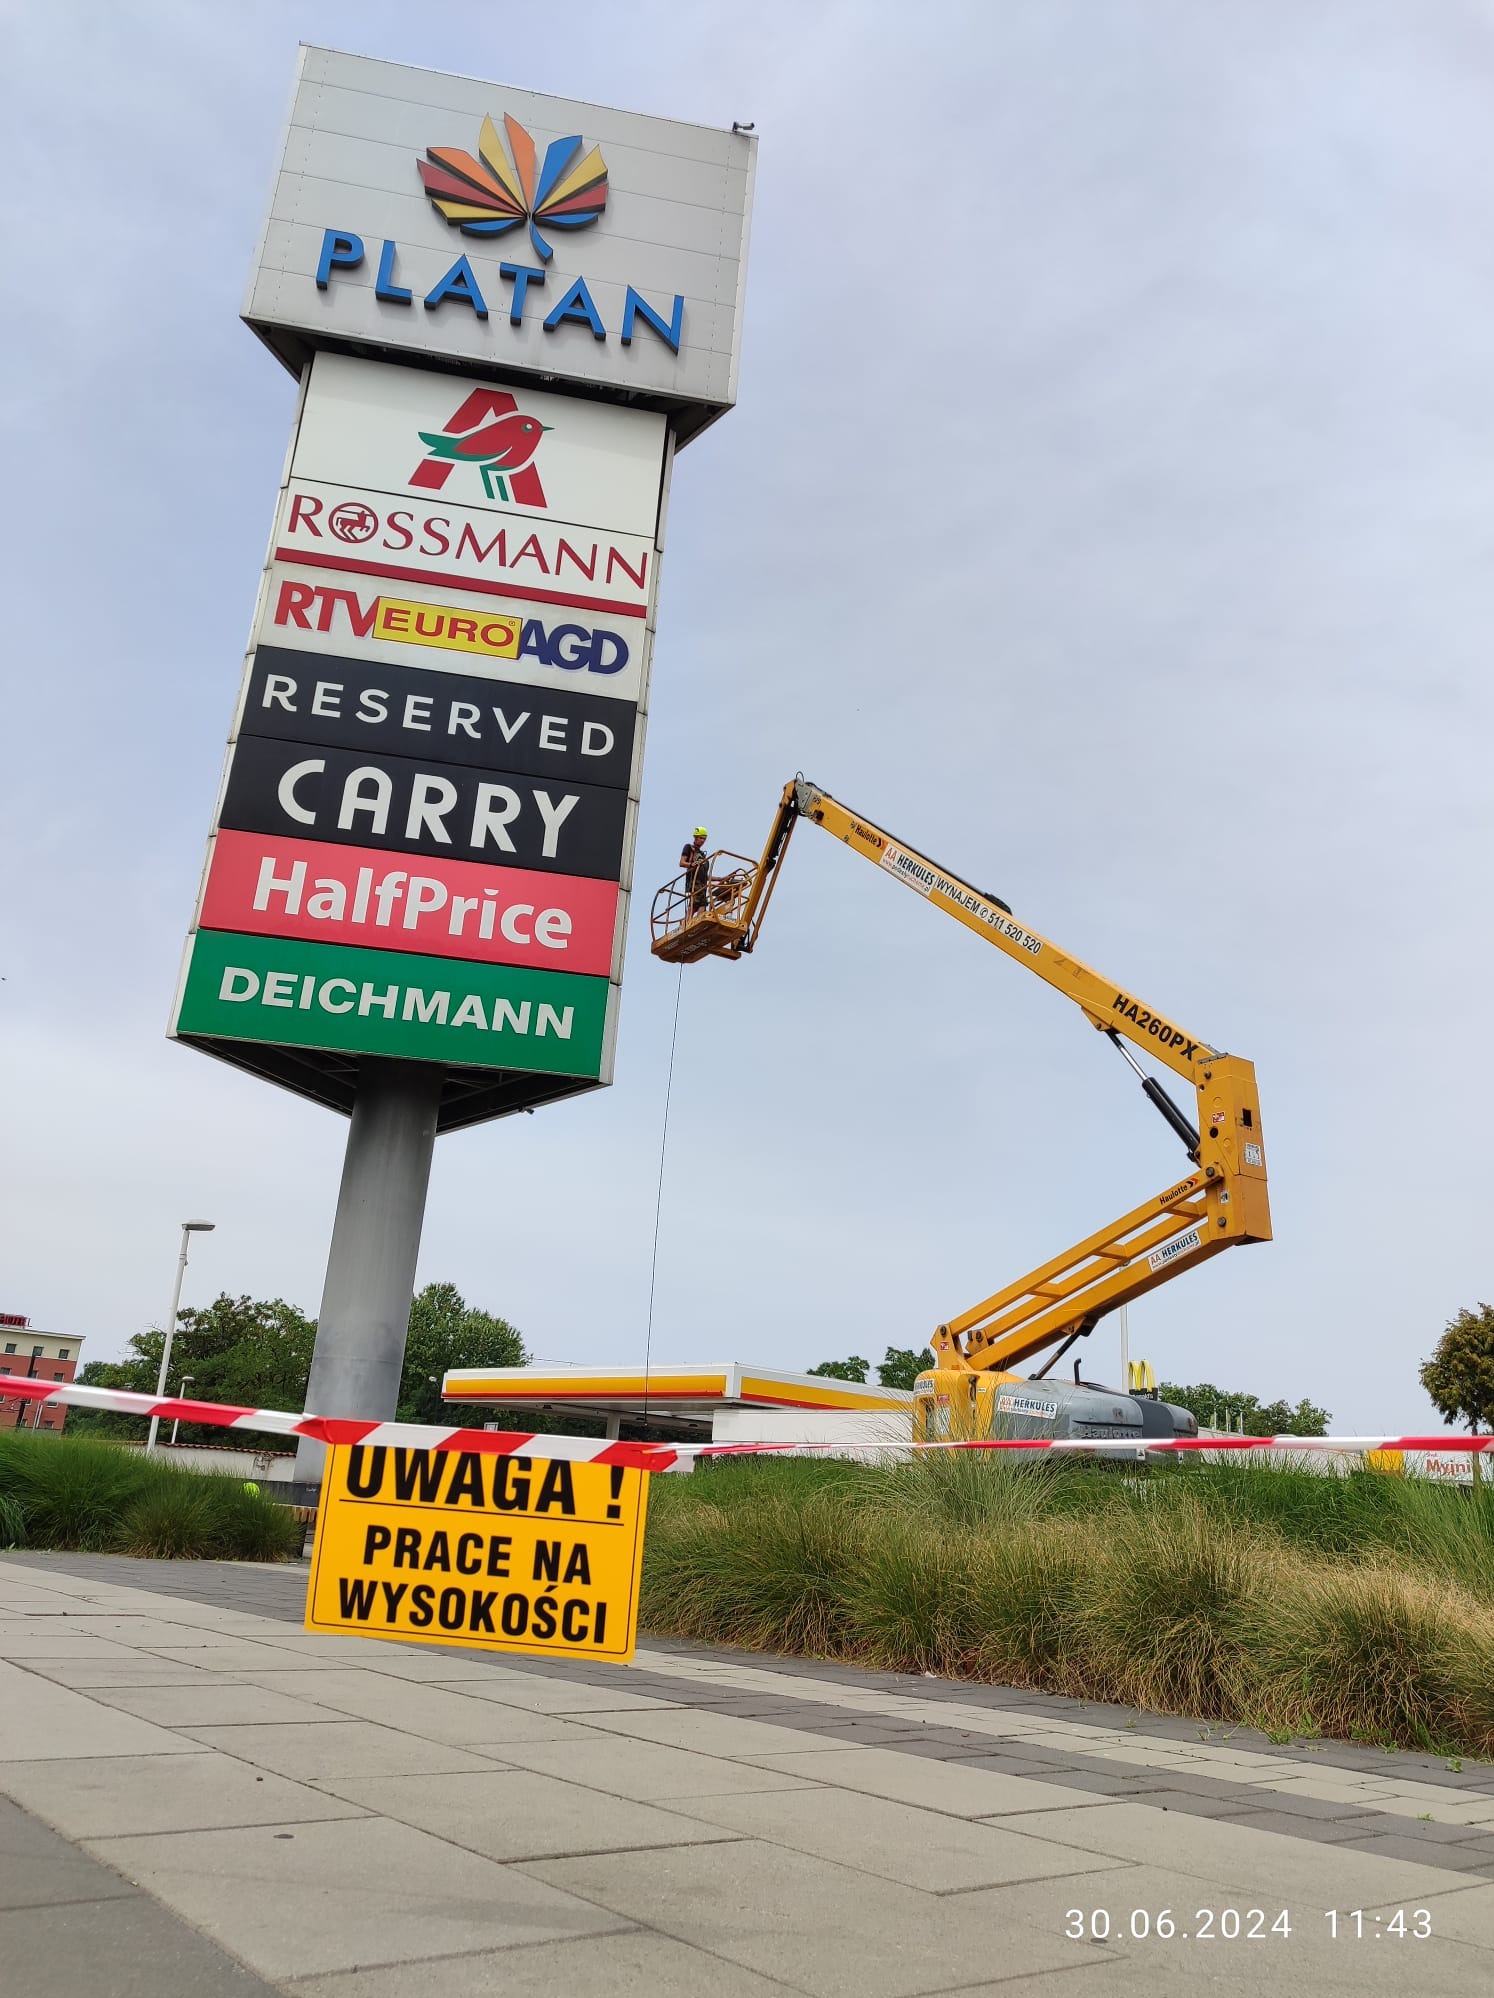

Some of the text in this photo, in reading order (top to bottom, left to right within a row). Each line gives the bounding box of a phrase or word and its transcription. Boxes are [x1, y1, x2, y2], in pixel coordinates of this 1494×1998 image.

[315, 228, 685, 355] PLATAN
[288, 494, 648, 590] ROSSMANN
[274, 580, 630, 675] RTV EURO AGD
[262, 674, 615, 756] RESERVED
[277, 759, 580, 858] CARRY
[885, 847, 935, 886] AA HERKULES
[252, 856, 573, 949] HalfPrice
[937, 877, 1041, 954] WYNAJEM 511 520 520
[218, 966, 575, 1040] DEICHMANN
[1112, 993, 1199, 1061] HA260PX
[1159, 1184, 1188, 1205] Haulotte
[1162, 1231, 1198, 1259] HERKULES
[1013, 1398, 1056, 1412] HERKULES
[347, 1445, 576, 1515] UWAGA
[1426, 1458, 1482, 1476] Myjni
[363, 1525, 592, 1586] PRACE NA
[339, 1578, 607, 1644] WYSOKOŚCI
